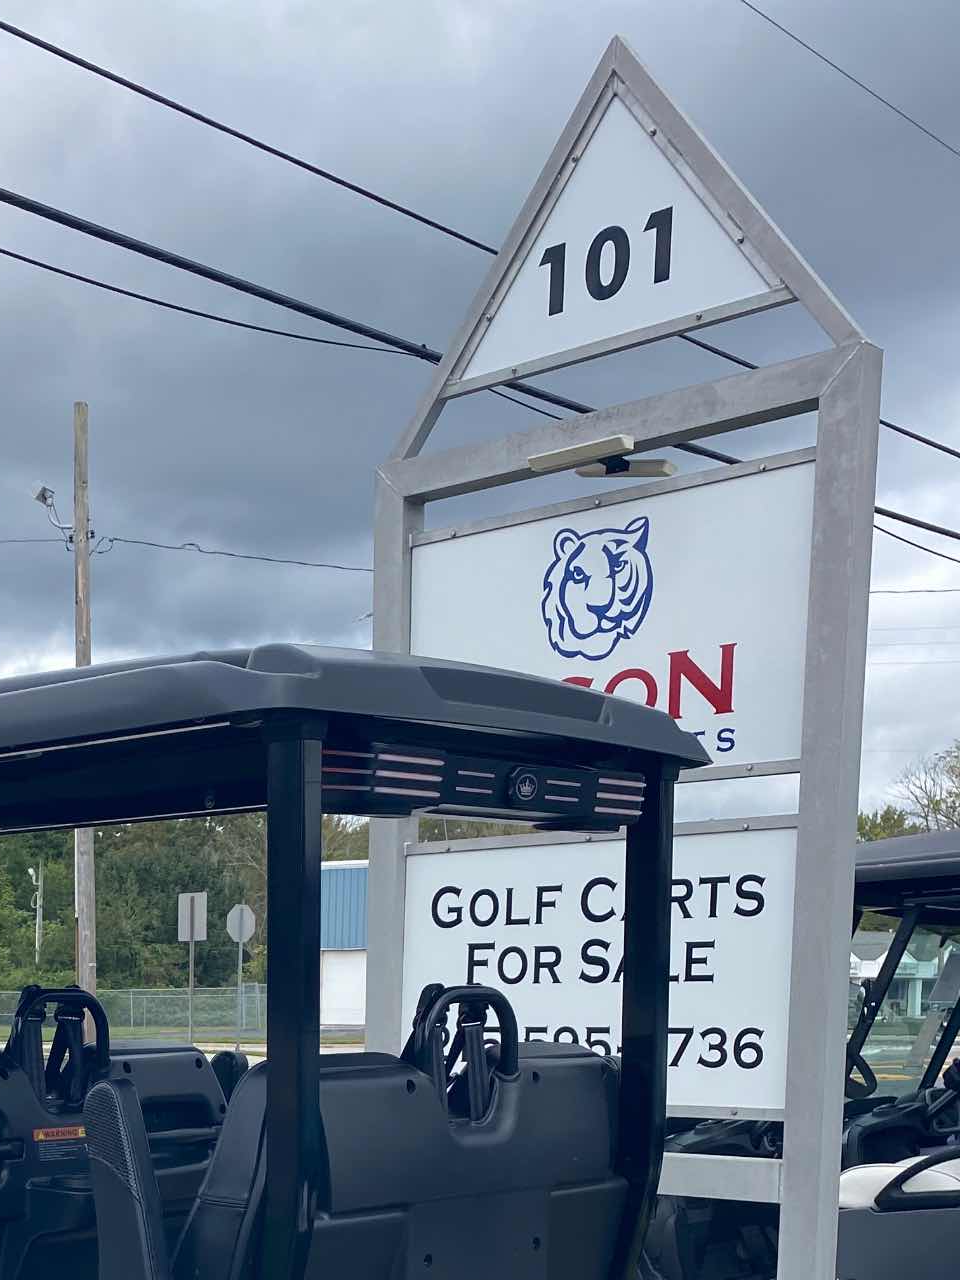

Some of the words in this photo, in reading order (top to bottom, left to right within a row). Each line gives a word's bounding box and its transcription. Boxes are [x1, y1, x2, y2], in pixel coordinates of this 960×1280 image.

[539, 206, 673, 317] 101
[431, 883, 563, 929] GOLF
[580, 874, 767, 923] CRTS
[466, 940, 562, 985] FOR
[578, 938, 716, 984] SE
[42, 1128, 79, 1137] WARNING
